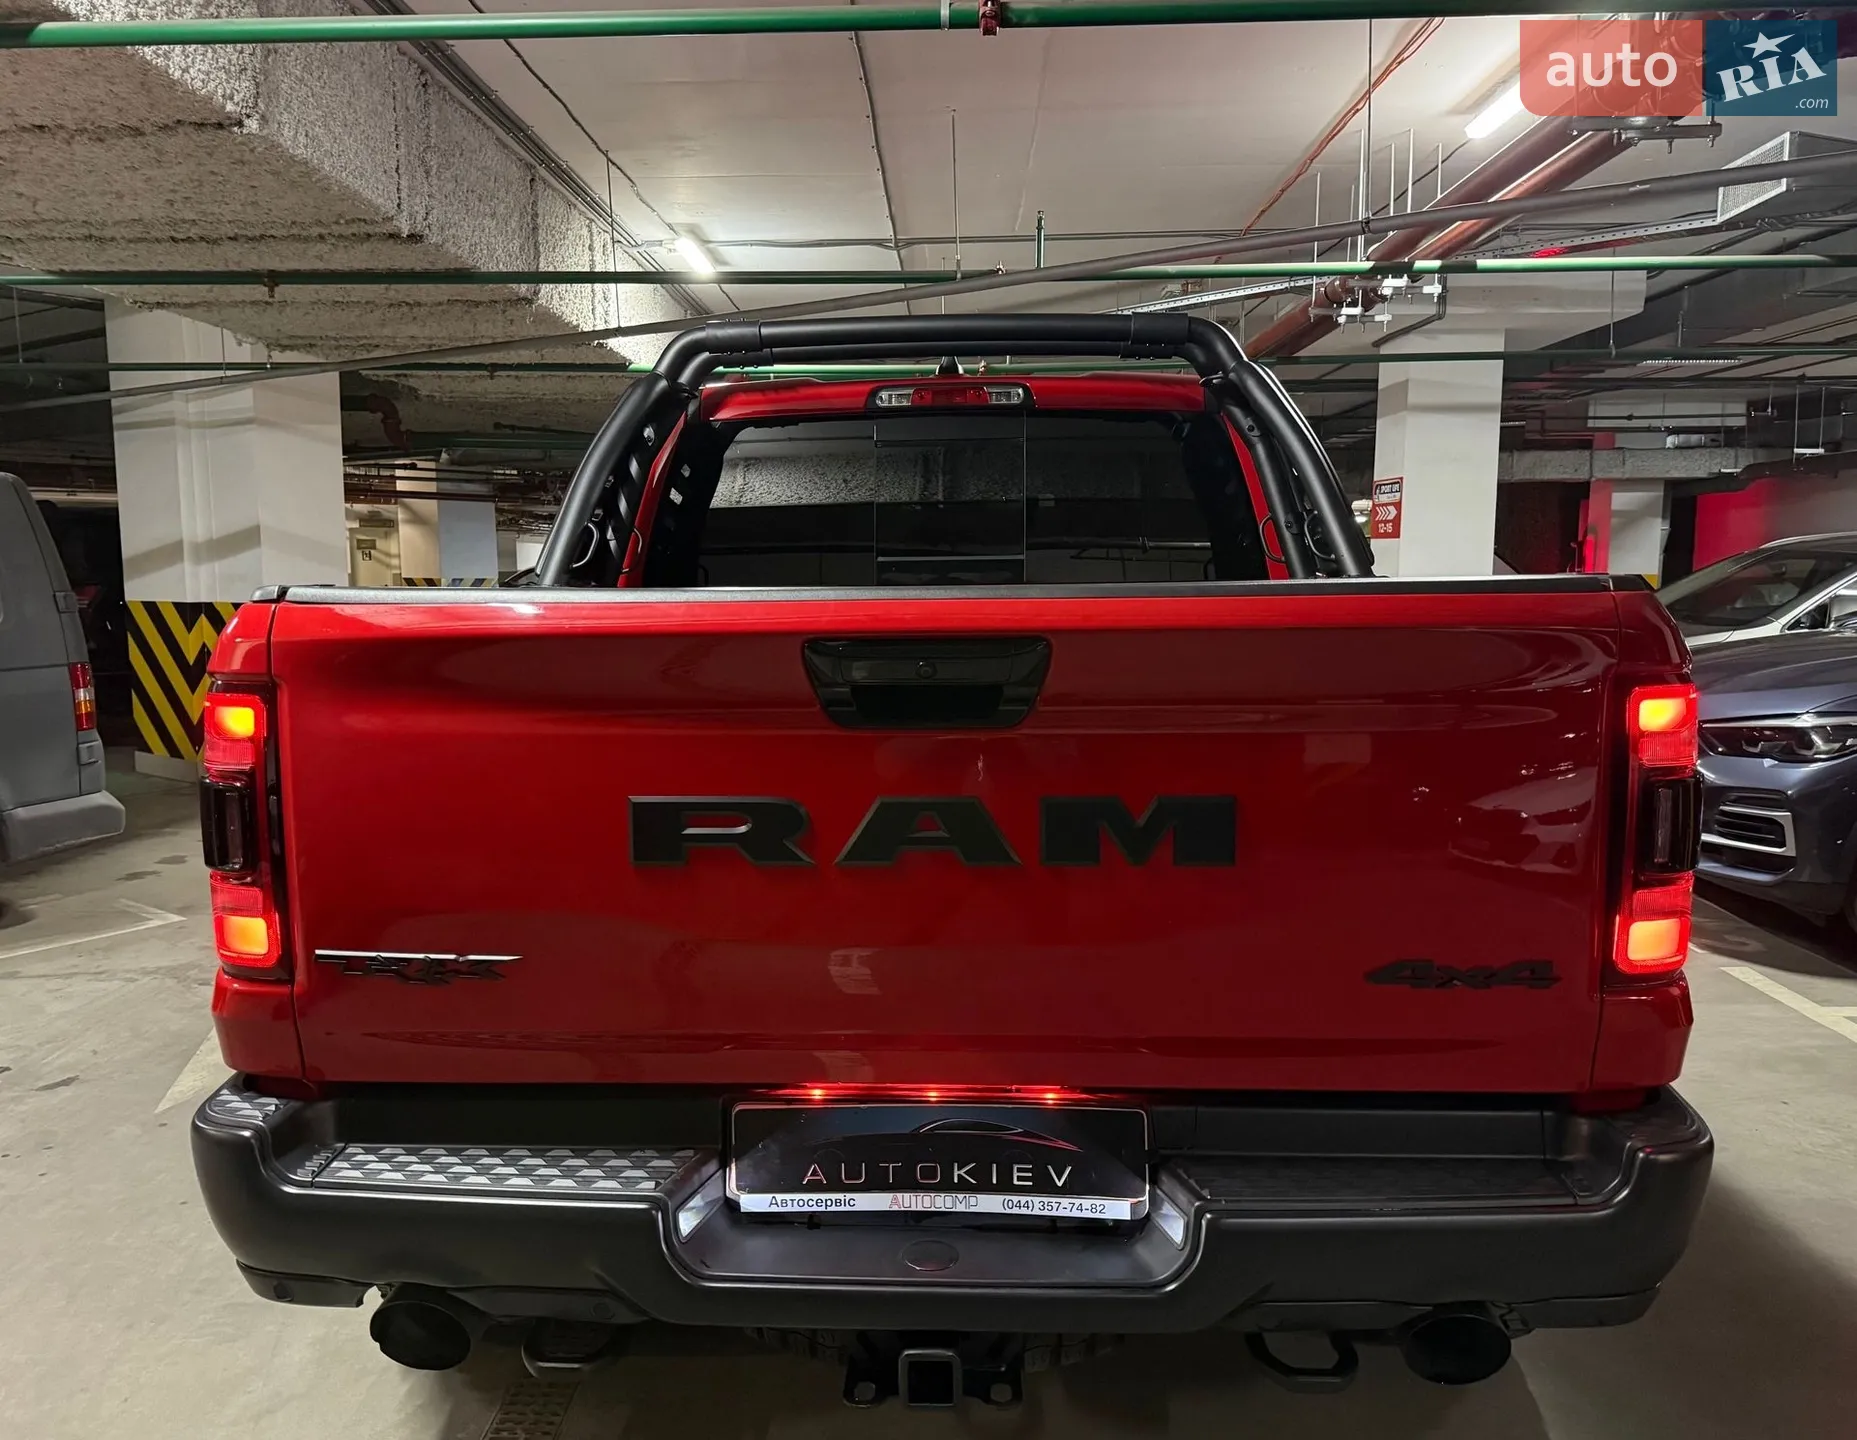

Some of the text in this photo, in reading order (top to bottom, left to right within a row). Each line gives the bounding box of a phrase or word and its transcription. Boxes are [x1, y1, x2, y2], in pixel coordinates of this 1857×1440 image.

[627, 795, 1237, 868] RAM
[802, 1162, 1073, 1188] AUTOKIEV
[768, 1195, 856, 1211] Автосервіс
[888, 1193, 979, 1211] AUTOCOMP
[1001, 1198, 1107, 1216] (044) 357-74-82
